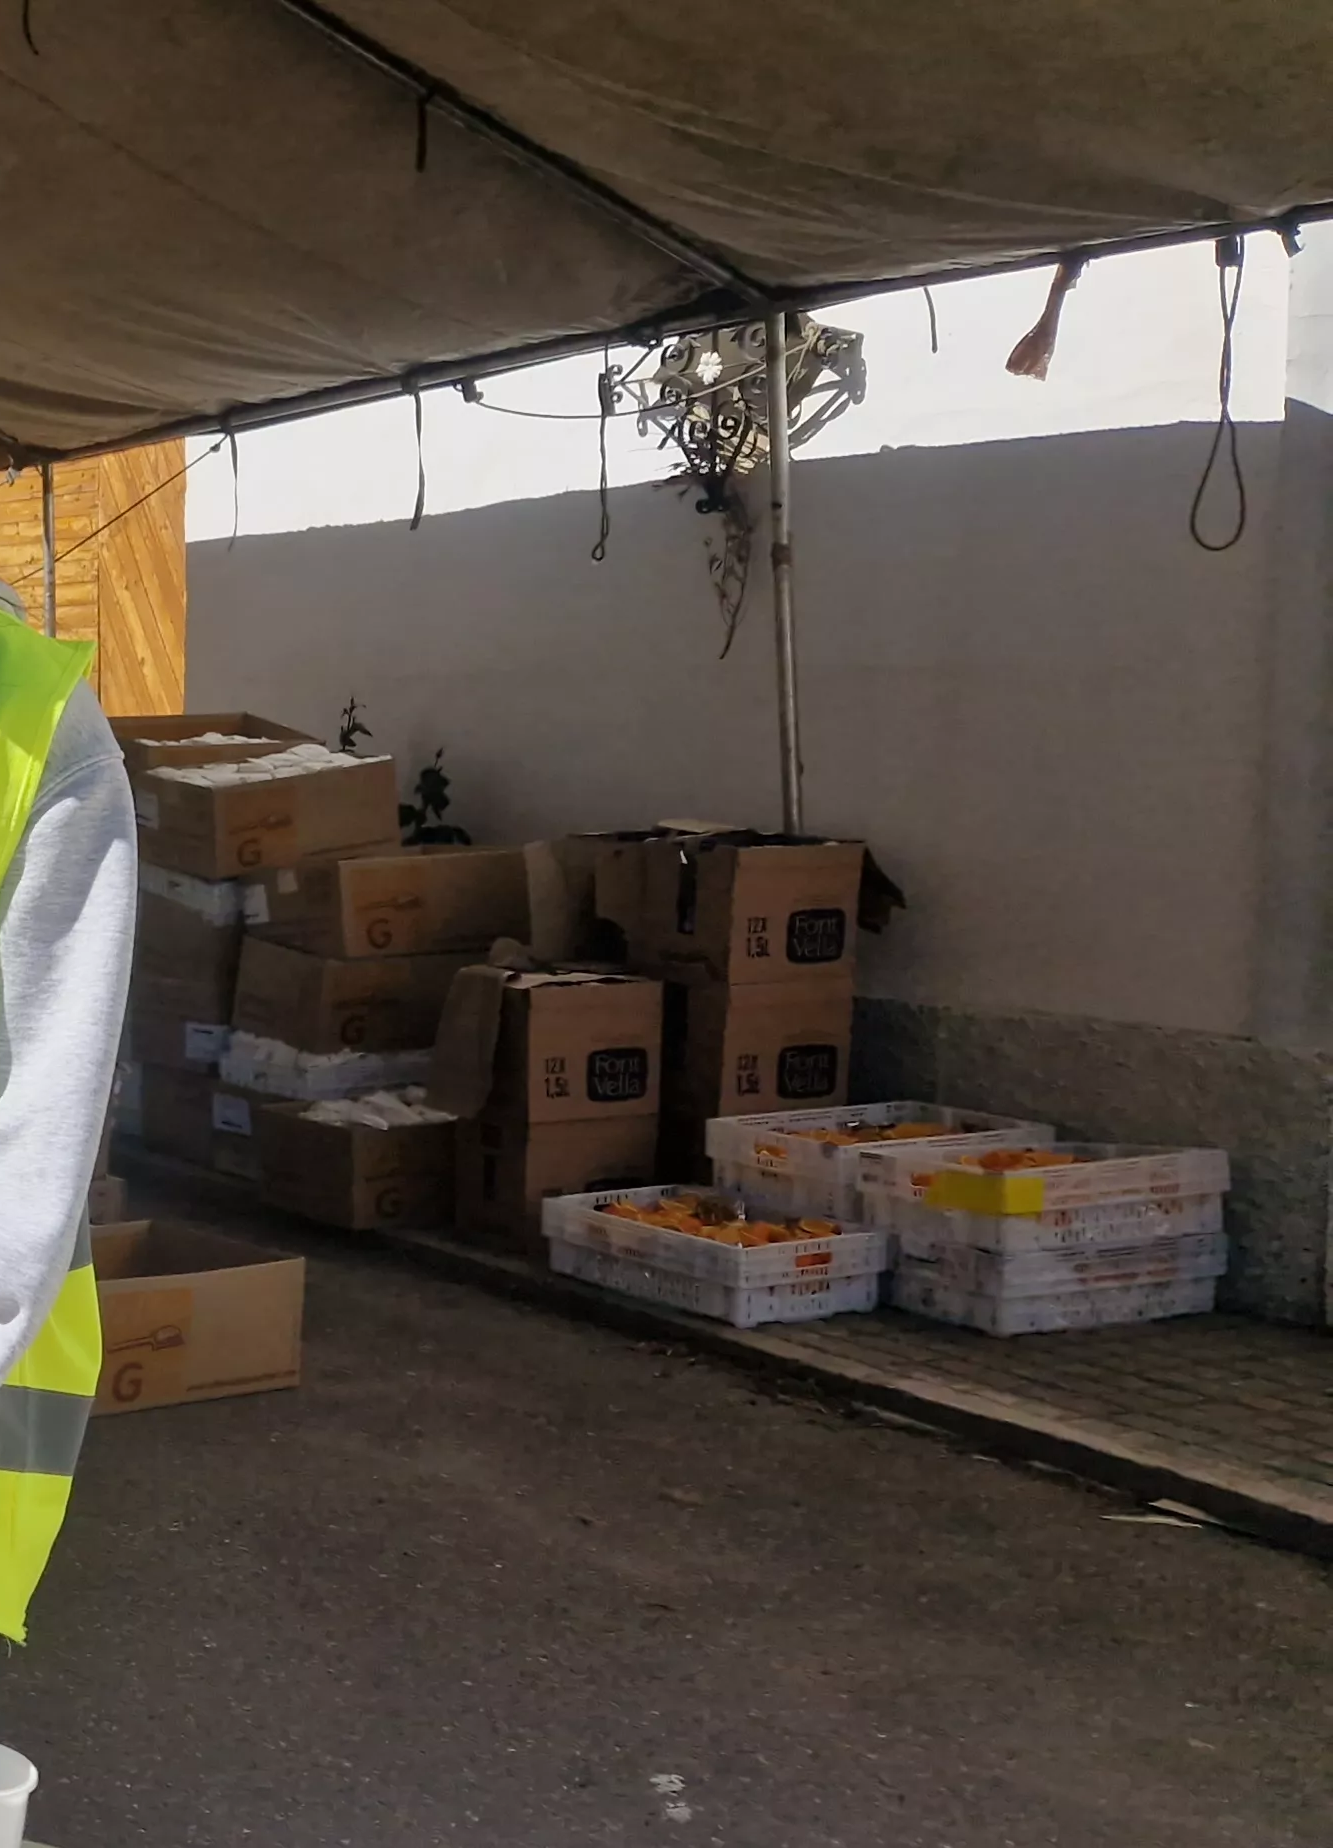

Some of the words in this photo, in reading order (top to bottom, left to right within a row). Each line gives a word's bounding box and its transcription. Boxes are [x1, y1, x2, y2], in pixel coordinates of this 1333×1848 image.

[235, 836, 263, 868] G
[366, 917, 394, 949] G
[794, 915, 838, 935] Font
[793, 936, 839, 957] Vella
[595, 1054, 640, 1075] Font
[593, 1073, 640, 1096] Vella
[110, 1361, 144, 1403] G
